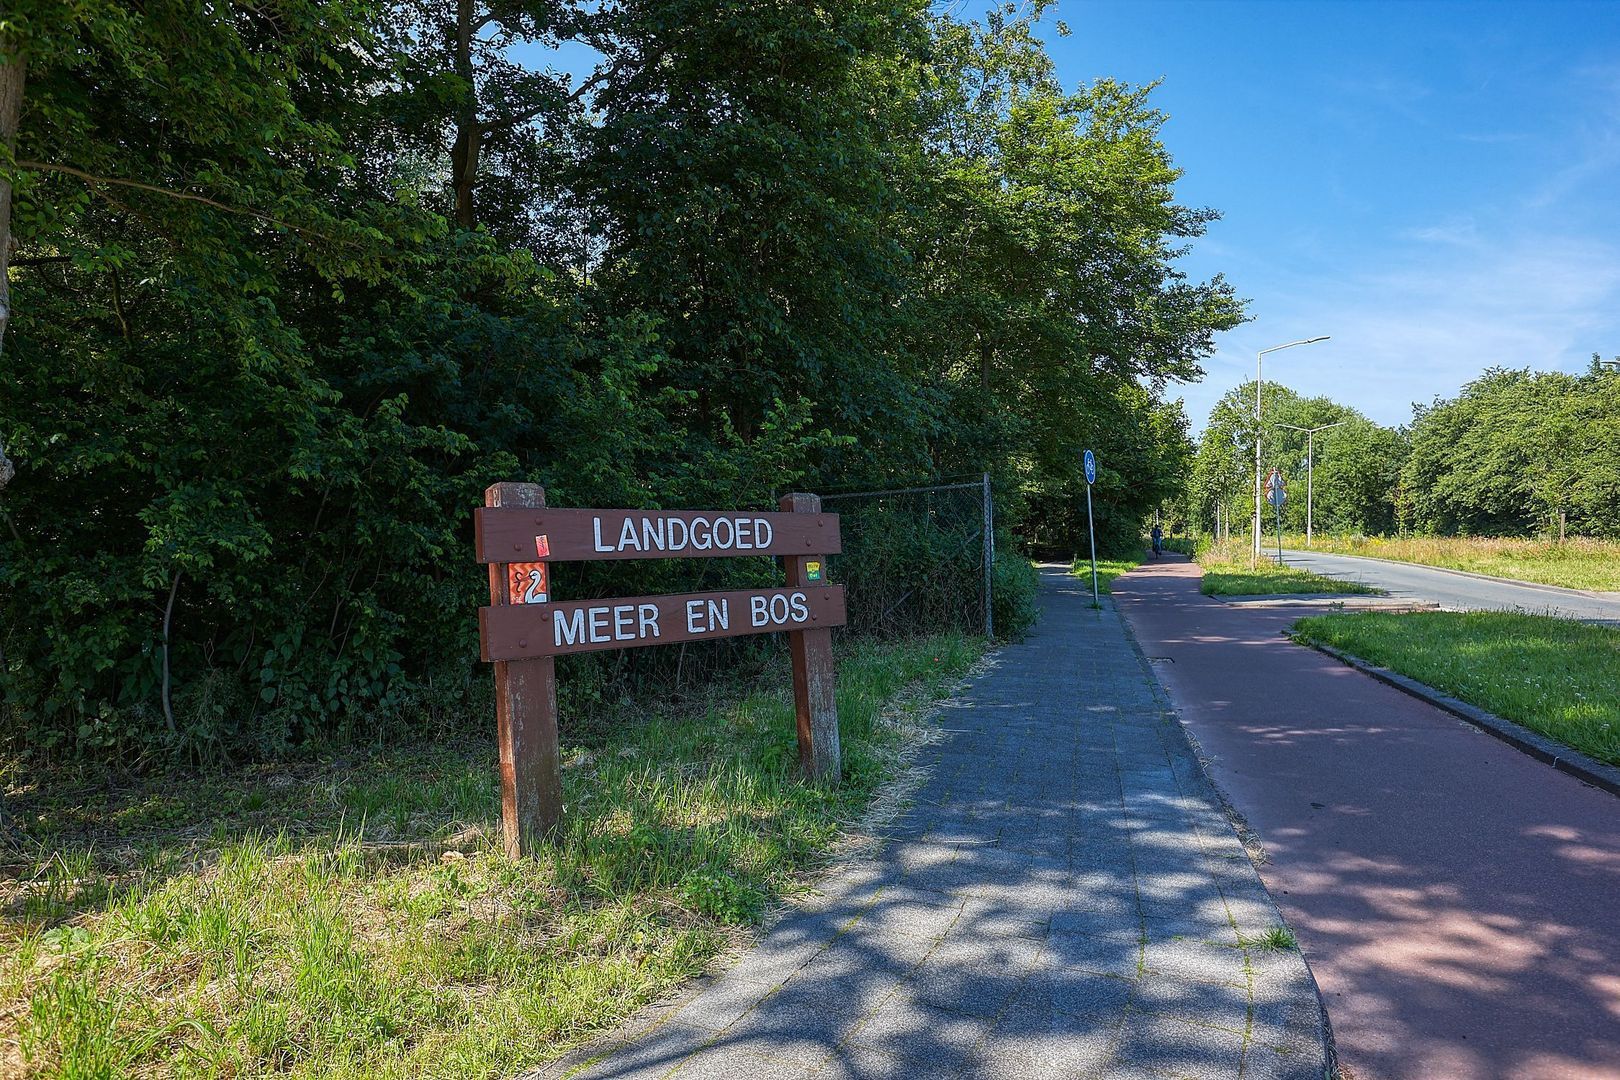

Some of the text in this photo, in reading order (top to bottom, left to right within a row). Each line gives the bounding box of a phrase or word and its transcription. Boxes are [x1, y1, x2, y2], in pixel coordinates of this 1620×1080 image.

[592, 516, 774, 552] LANDGOED
[553, 592, 809, 647] MEER EN BOS
